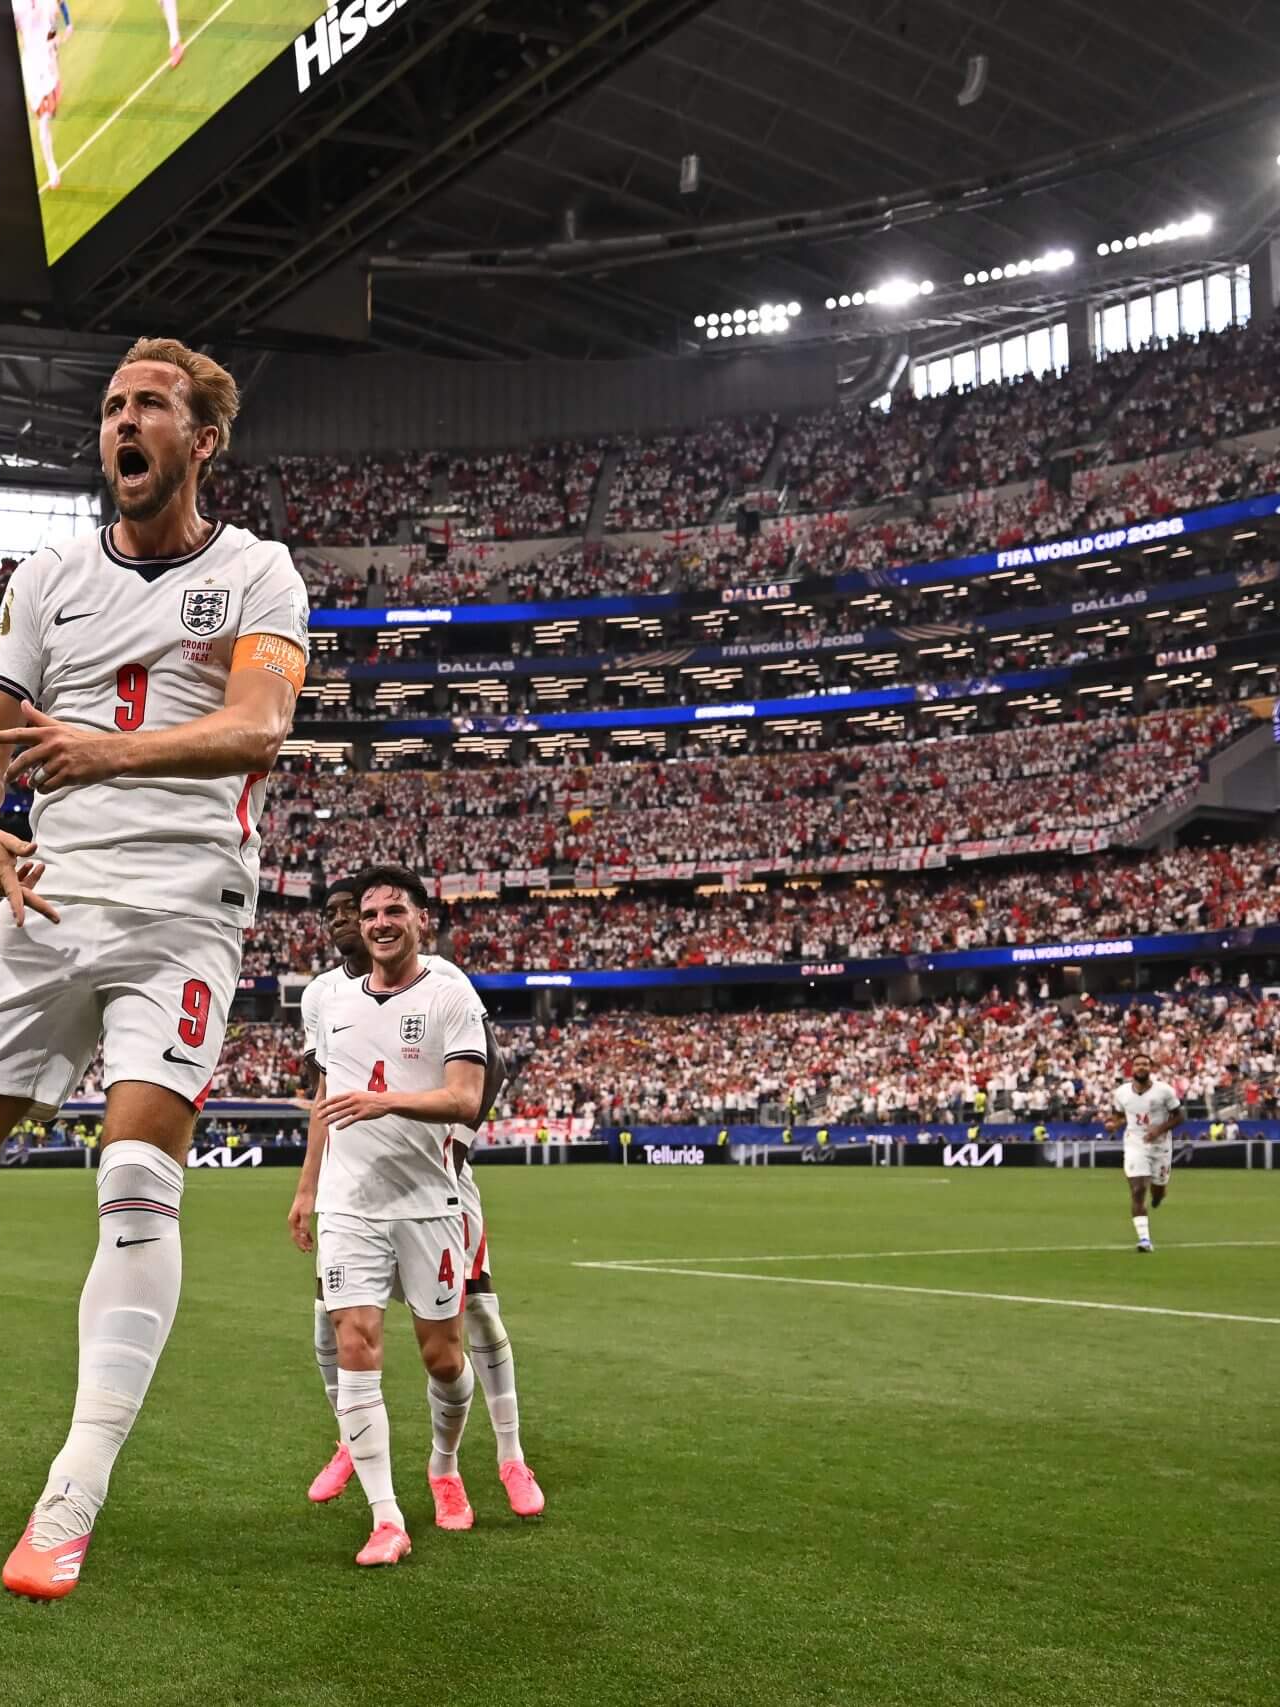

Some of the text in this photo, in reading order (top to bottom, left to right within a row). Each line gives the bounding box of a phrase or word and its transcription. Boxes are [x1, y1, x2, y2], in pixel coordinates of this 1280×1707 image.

[996, 517, 1184, 568] FIFA WORLD CUP 2026
[721, 584, 792, 602] DALLAS
[1071, 589, 1148, 615] DALLAS
[181, 639, 213, 651] CROATIA
[722, 645, 749, 657] FIFA
[750, 641, 794, 654] WORLD
[821, 632, 865, 648] 2026
[1155, 644, 1217, 667] DALLAS
[437, 660, 516, 673] DALLAS
[114, 662, 149, 712] 9
[1012, 949, 1035, 961] FIFA
[1035, 946, 1073, 960] WORLD
[1073, 944, 1095, 957] CUP
[178, 978, 212, 1048] 9
[367, 1060, 388, 1093] 4
[1135, 1112, 1151, 1126] 24
[187, 1147, 262, 1168] KIA
[643, 1145, 704, 1165] Telluride
[943, 1143, 1003, 1167] KIA
[438, 1248, 455, 1291] 4
